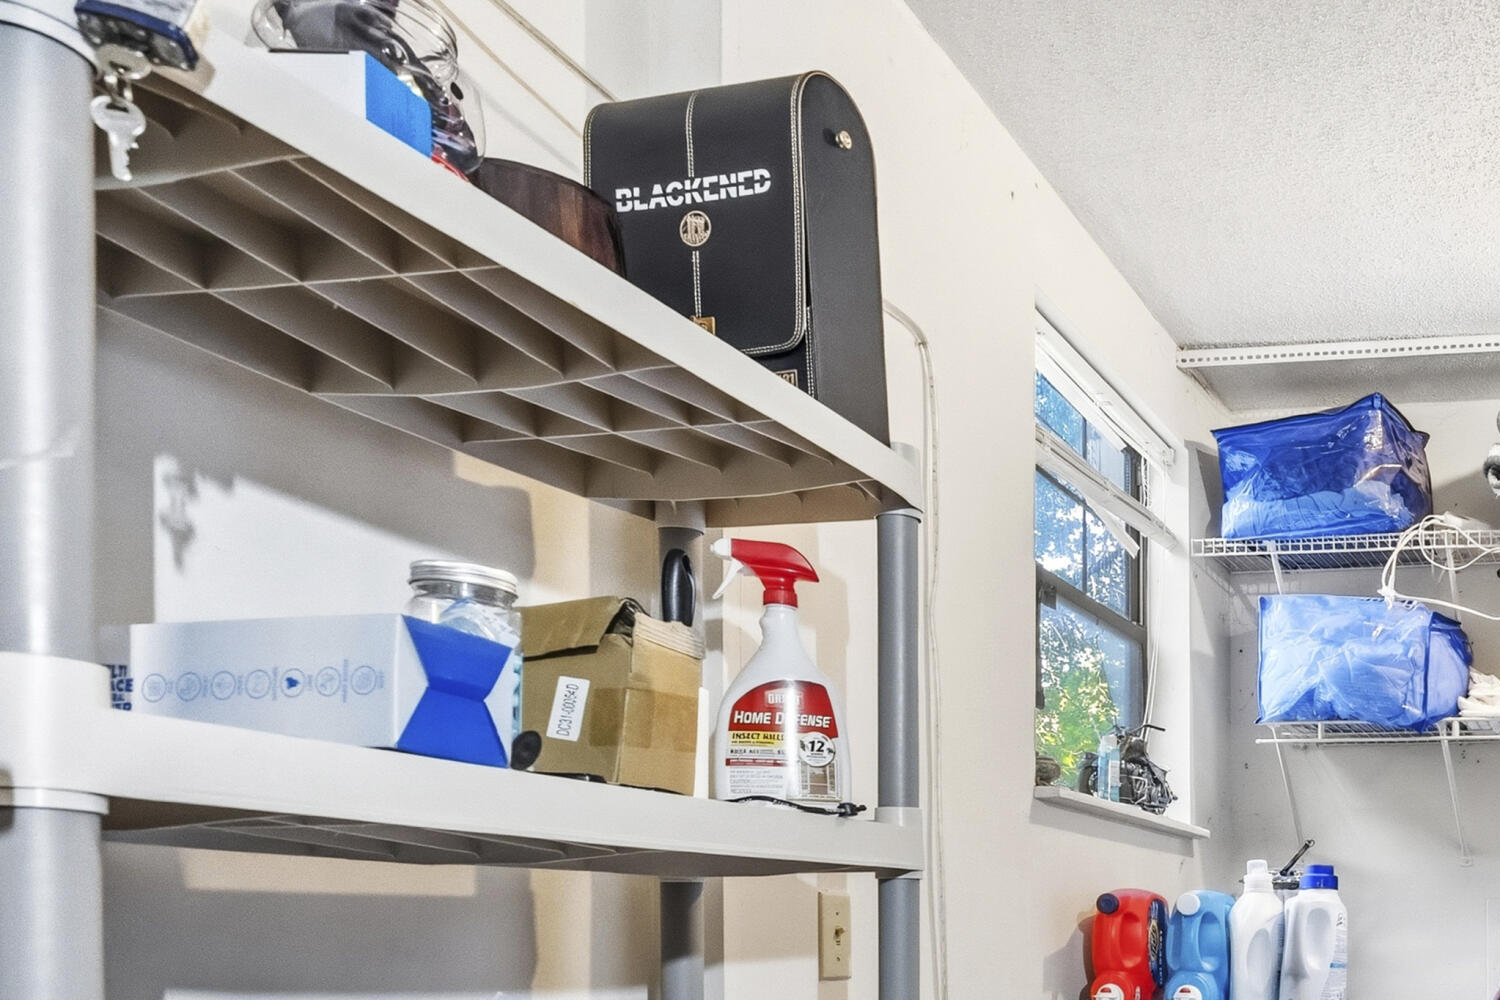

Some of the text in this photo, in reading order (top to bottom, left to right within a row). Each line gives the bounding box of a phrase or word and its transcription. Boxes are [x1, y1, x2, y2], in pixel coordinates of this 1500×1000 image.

[615, 168, 772, 213] BLACKENED
[733, 711, 832, 729] HOME DENSE
[808, 740, 825, 753] 12
